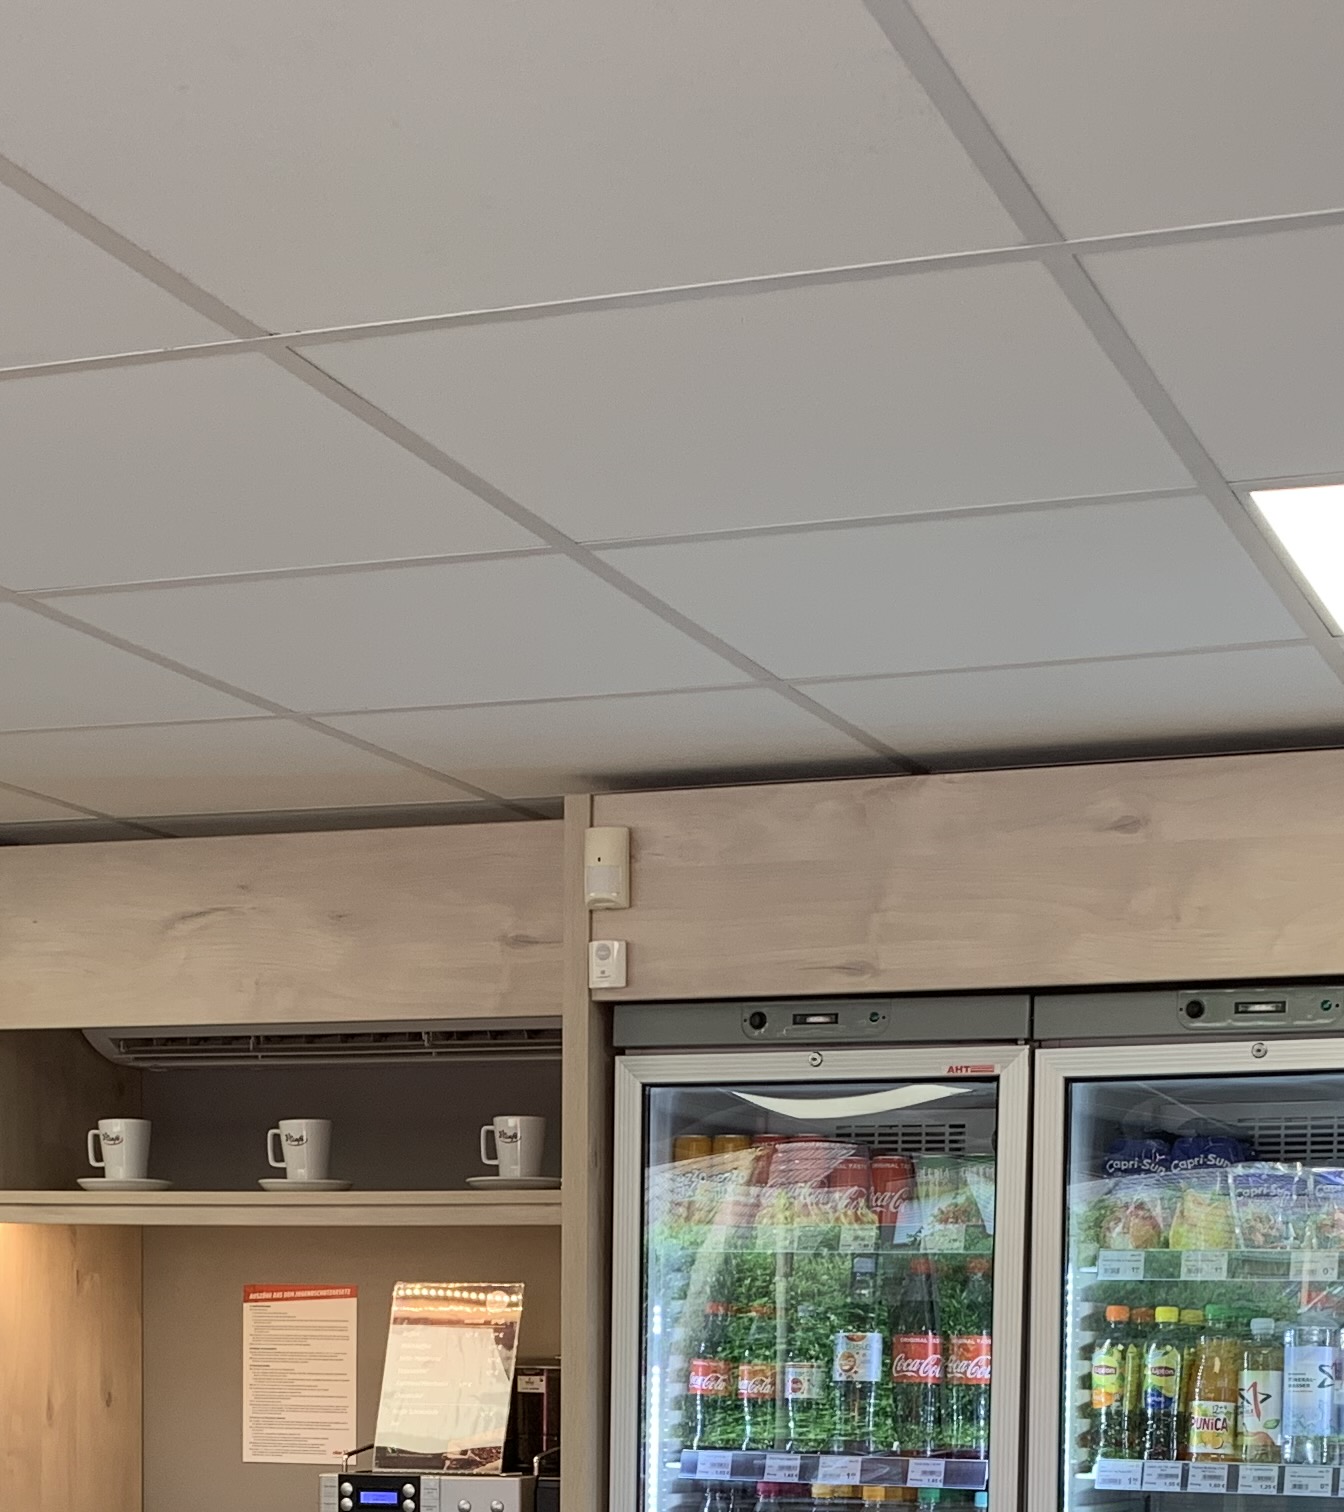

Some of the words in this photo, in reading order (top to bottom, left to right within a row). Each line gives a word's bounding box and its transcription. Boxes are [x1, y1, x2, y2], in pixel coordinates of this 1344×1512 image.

[947, 1065, 971, 1073] AHT
[1106, 1155, 1166, 1174] Capri-Sun
[1171, 1153, 1231, 1173] Capri-Sun
